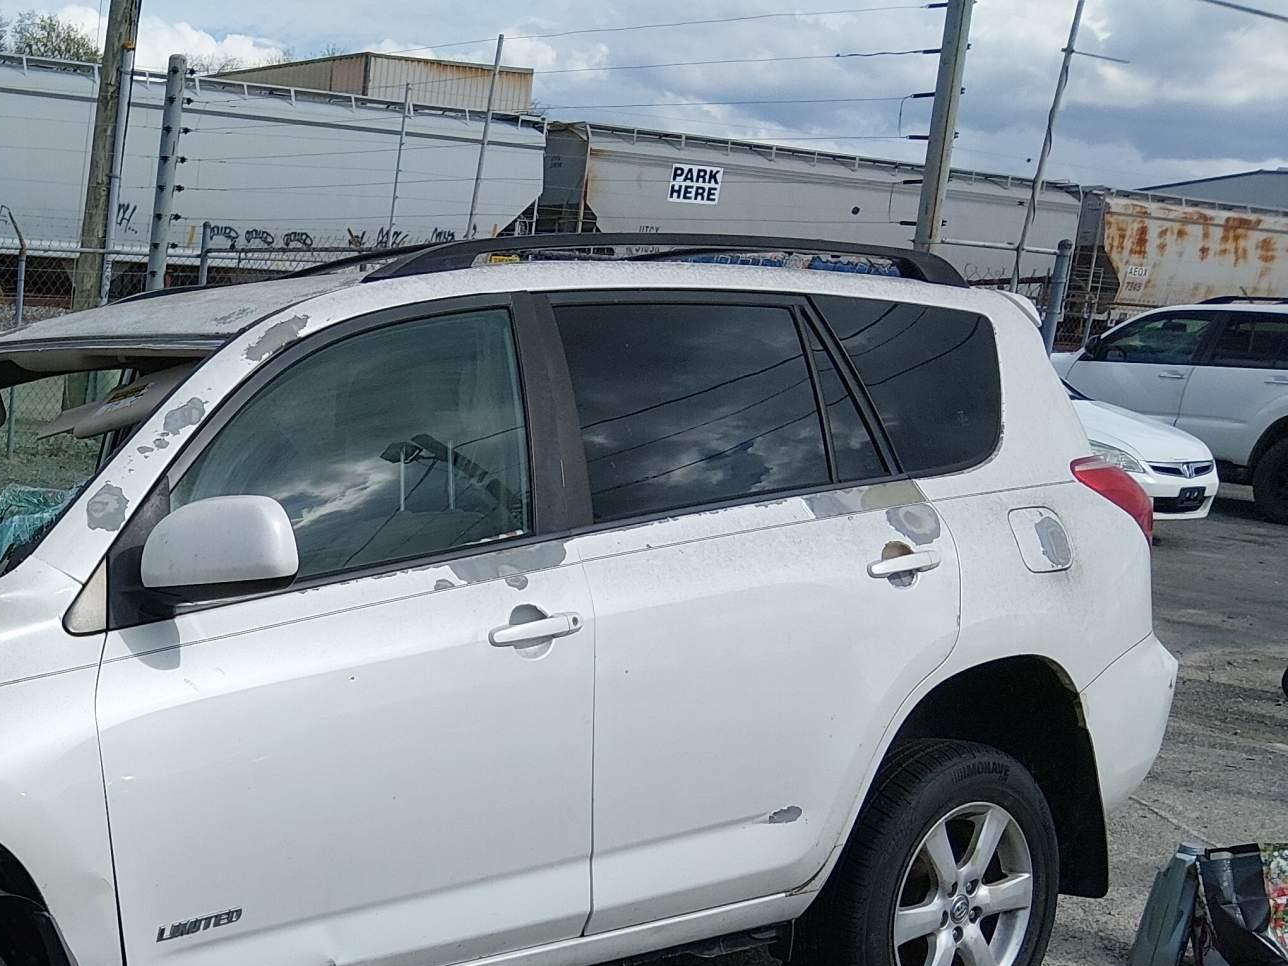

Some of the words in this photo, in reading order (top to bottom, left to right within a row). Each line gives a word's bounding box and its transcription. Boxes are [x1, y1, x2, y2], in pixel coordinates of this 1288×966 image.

[672, 167, 720, 185] PARK
[669, 184, 717, 202] HERE
[155, 907, 242, 943] LIMITED
